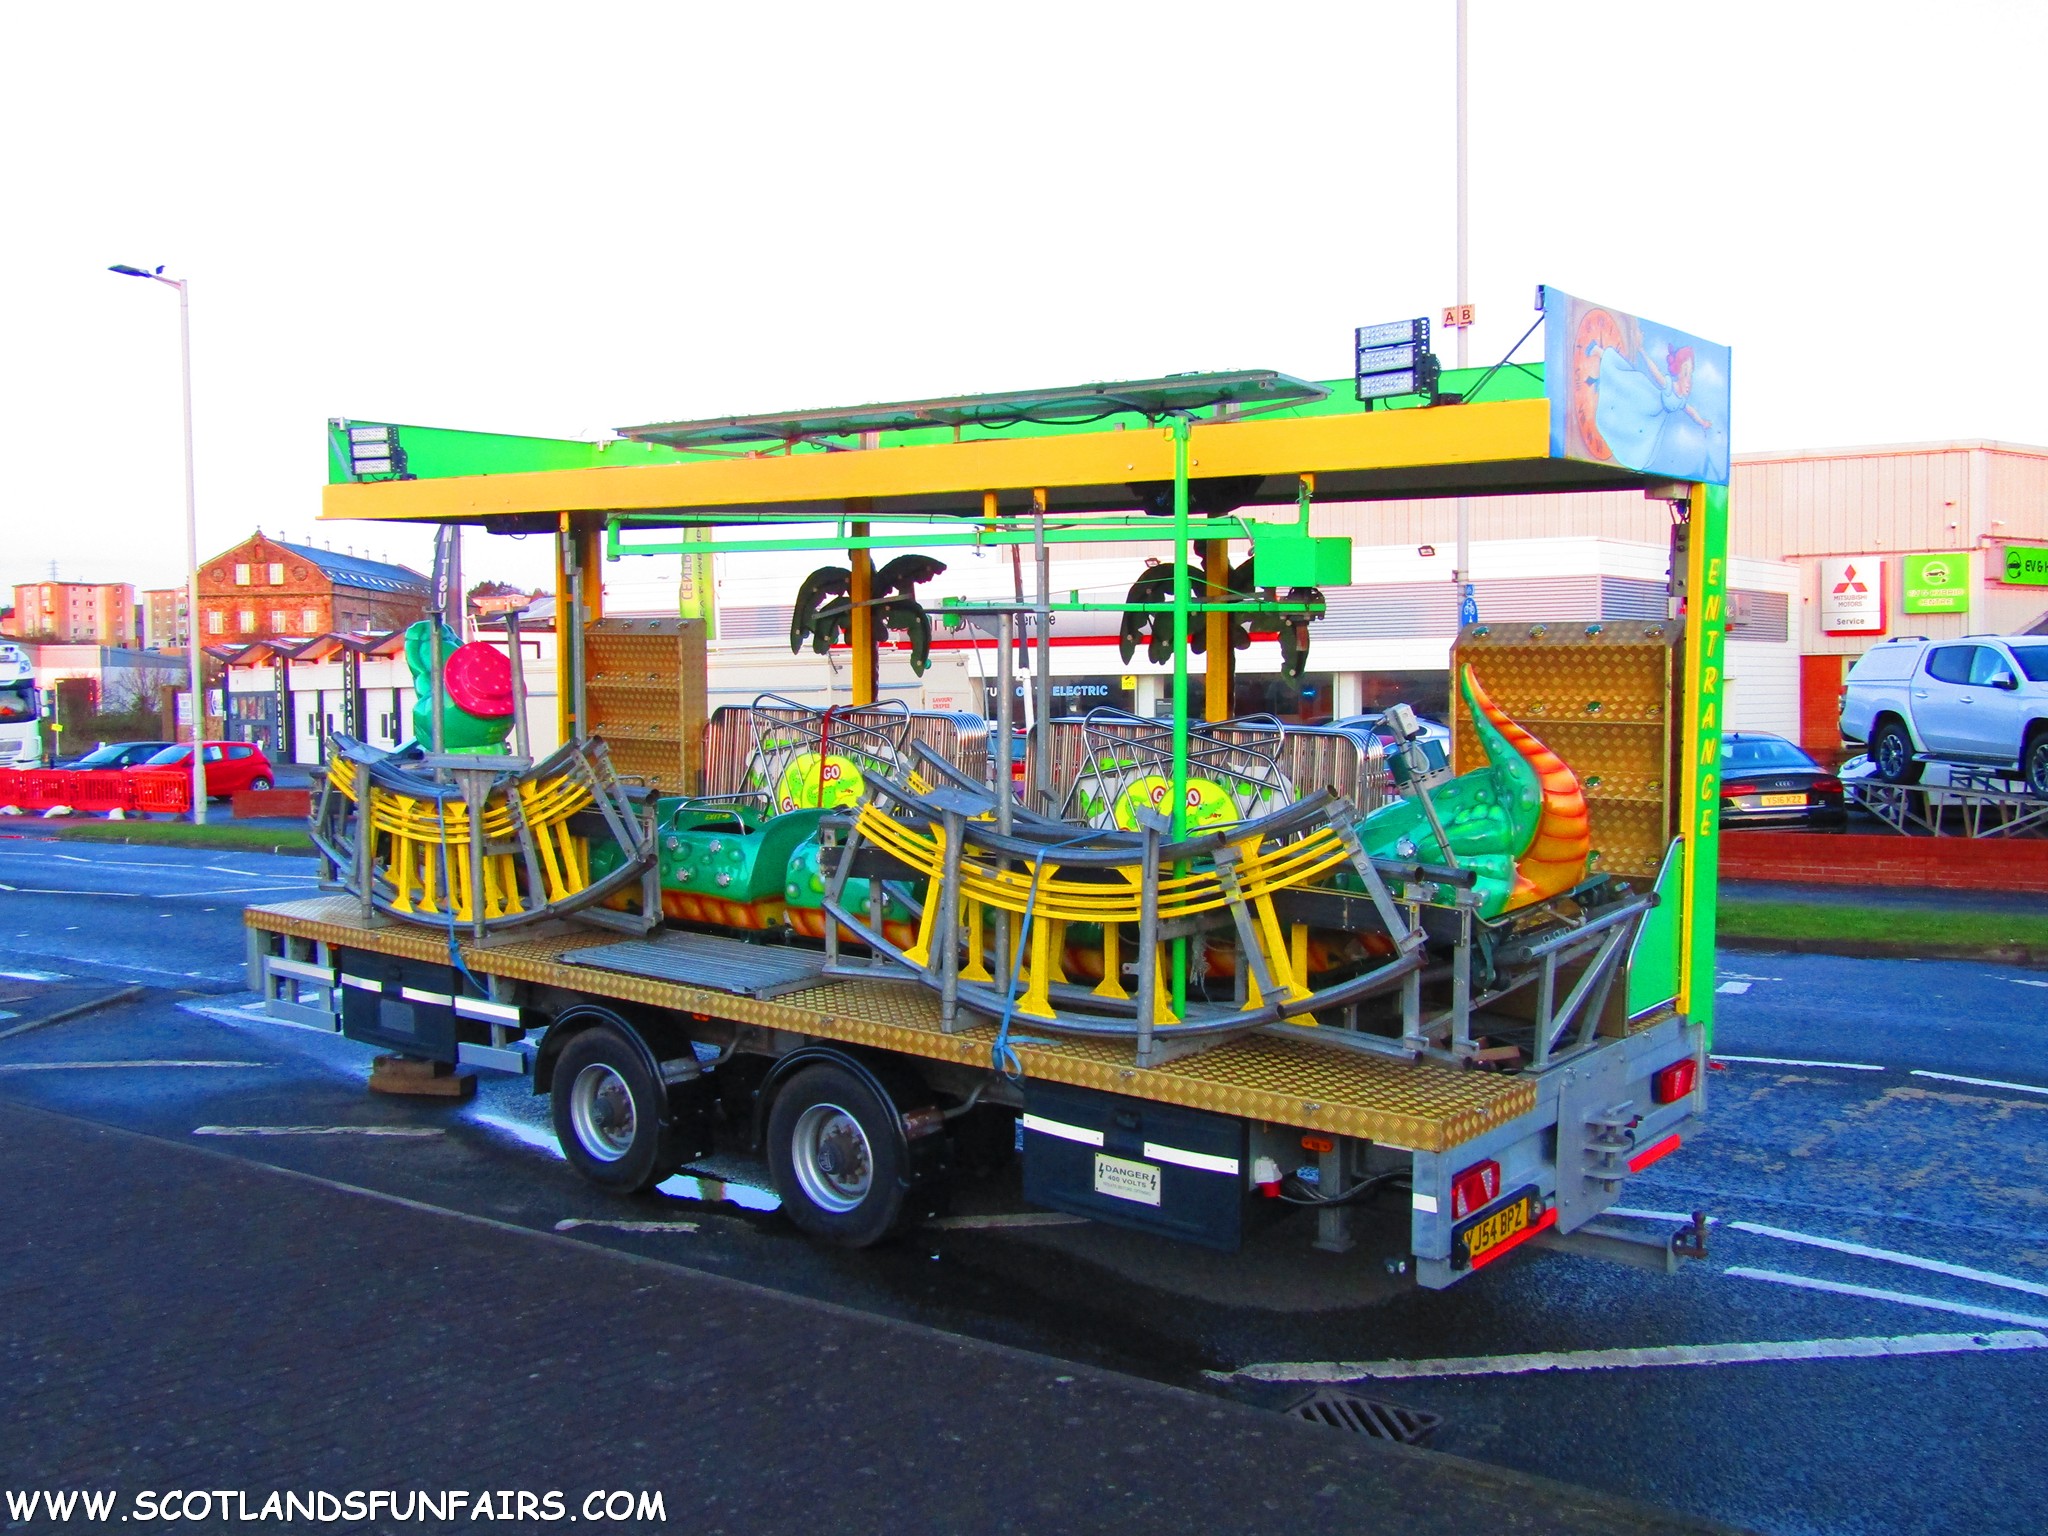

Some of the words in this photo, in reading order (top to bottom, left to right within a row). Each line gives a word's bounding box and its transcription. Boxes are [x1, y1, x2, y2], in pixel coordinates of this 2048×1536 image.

[1445, 312, 1454, 322] A
[1462, 310, 1471, 320] B
[2025, 560, 2036, 572] EV
[2037, 560, 2044, 573] &
[1836, 618, 1865, 626] Service
[1052, 685, 1109, 697] ELECTRIC
[1700, 558, 1721, 836] ENTRANCE
[823, 765, 840, 780] GO
[1105, 1164, 1150, 1181] DANGER
[1107, 1175, 1121, 1183] 400
[1121, 1178, 1147, 1189] VOLTS
[1500, 1202, 1523, 1236] BPZ
